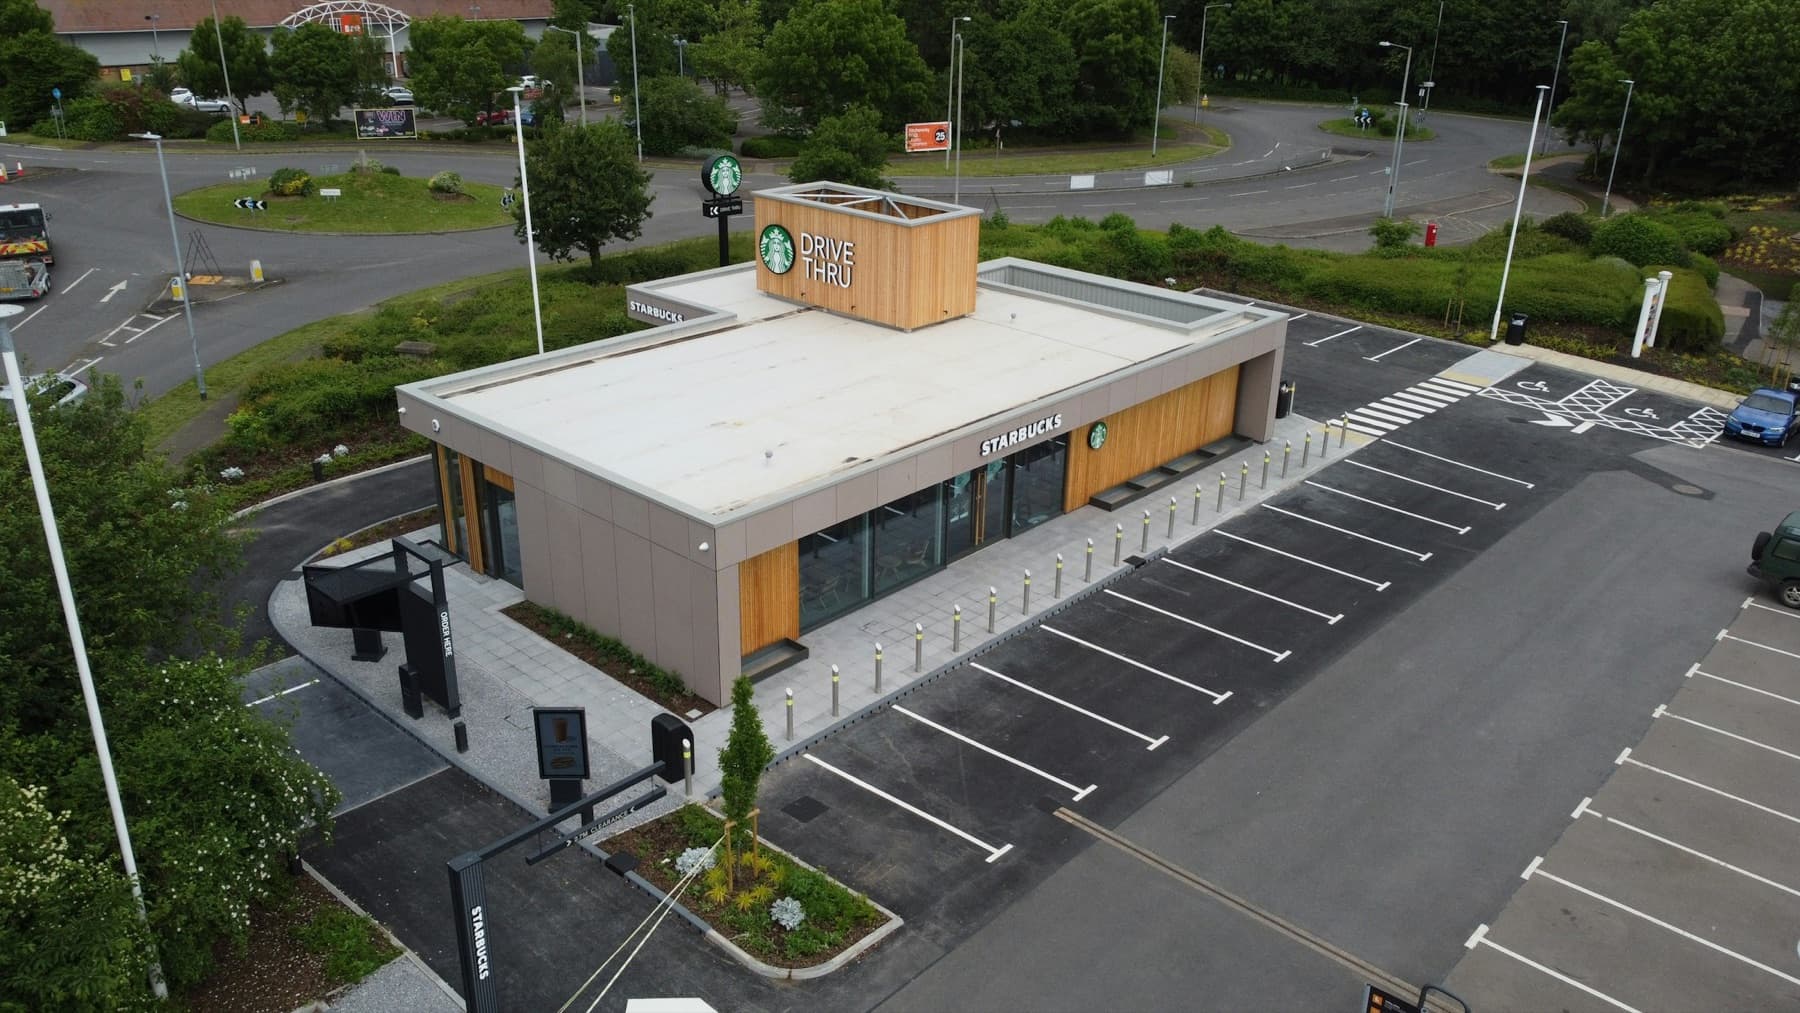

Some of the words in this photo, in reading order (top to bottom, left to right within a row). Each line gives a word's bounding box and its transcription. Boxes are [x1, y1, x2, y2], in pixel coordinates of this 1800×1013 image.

[376, 111, 406, 122] WIN
[935, 131, 946, 142] 25
[801, 232, 855, 265] DRIVE
[802, 257, 852, 288] THRU
[630, 301, 684, 323] STARBUCKS
[981, 414, 1062, 456] STARBUCKS
[441, 611, 450, 637] ORDER
[444, 637, 453, 658] HERE
[590, 810, 628, 833] CLEARANCE
[471, 905, 489, 980] STARBUCKS
